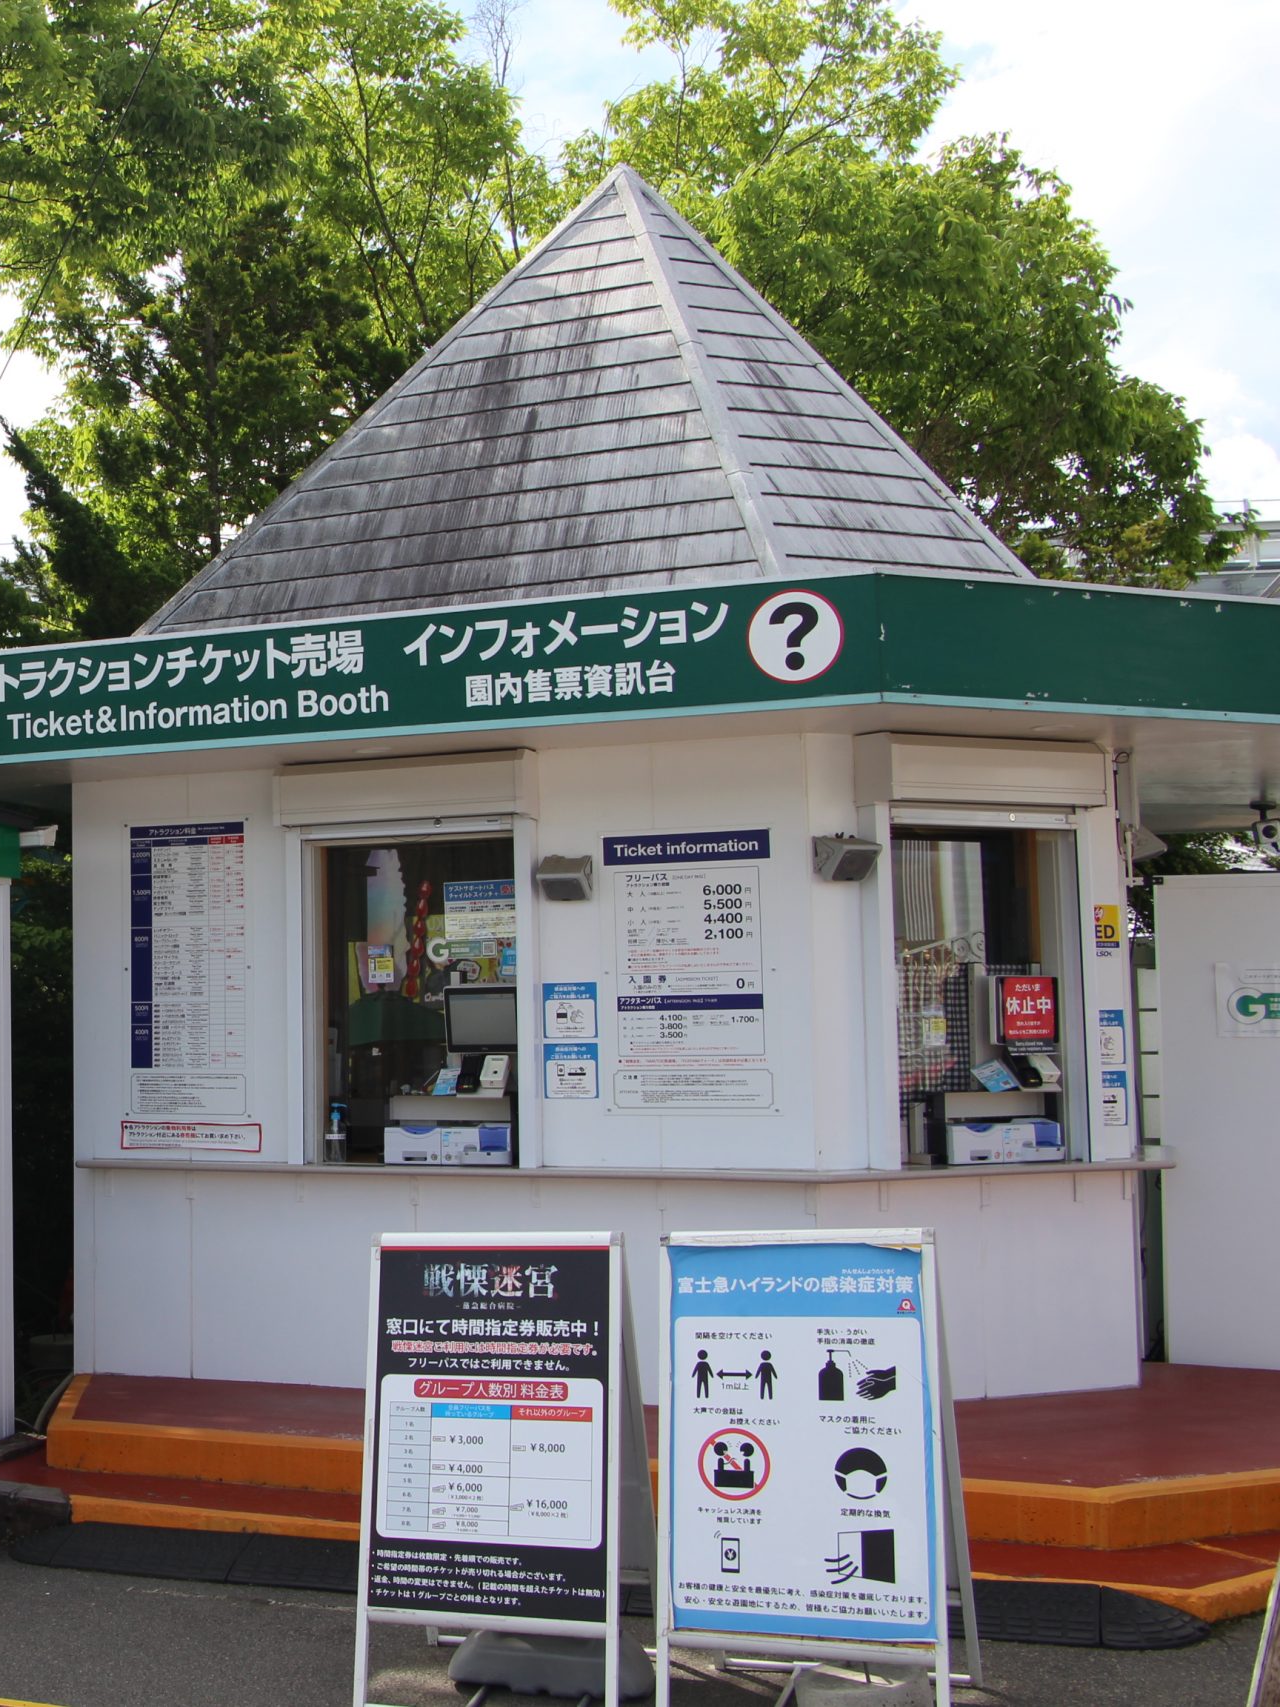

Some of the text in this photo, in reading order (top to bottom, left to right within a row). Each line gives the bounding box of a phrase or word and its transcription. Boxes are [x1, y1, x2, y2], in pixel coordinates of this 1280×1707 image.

[403, 600, 729, 667] インフォメーション
[6, 684, 390, 740] Ticket&Information Booth
[613, 839, 759, 857] Ticket information
[625, 873, 668, 882] フリーパス
[702, 884, 742, 896] 6,000
[703, 898, 743, 910] 5,500
[704, 912, 743, 925] 4,400
[704, 928, 744, 940] 2,100
[736, 978, 746, 989] 0
[1015, 984, 1041, 992] ただいま
[1006, 996, 1051, 1015] 休止中
[423, 1262, 559, 1299] 戦慄迷宮
[677, 1275, 914, 1294] 富士急ハイランドの感染症対策
[386, 1318, 598, 1338] 窓口にて時間指定券販売中!
[817, 1328, 868, 1336] 手洗い・うがい
[695, 1332, 772, 1340] 間隔を空けてください
[408, 1357, 570, 1371] フリーパスではご利用できません。
[419, 1381, 564, 1400] グループ人数別 料金表
[721, 1382, 750, 1391] 1m以上
[519, 1408, 586, 1418] それ以外のグループ
[693, 1407, 743, 1415] 大声での会話は
[729, 1418, 780, 1426] お控えください
[819, 1415, 876, 1424] マスクの着用に
[844, 1426, 902, 1436] ご協力ください
[450, 1435, 484, 1445] ¥3,000
[530, 1443, 566, 1453] ¥8,000
[448, 1464, 483, 1474] ¥4,000
[448, 1482, 482, 1492] ¥6,000
[526, 1499, 568, 1510] ¥16,000
[840, 1508, 891, 1519] 定期的な換気
